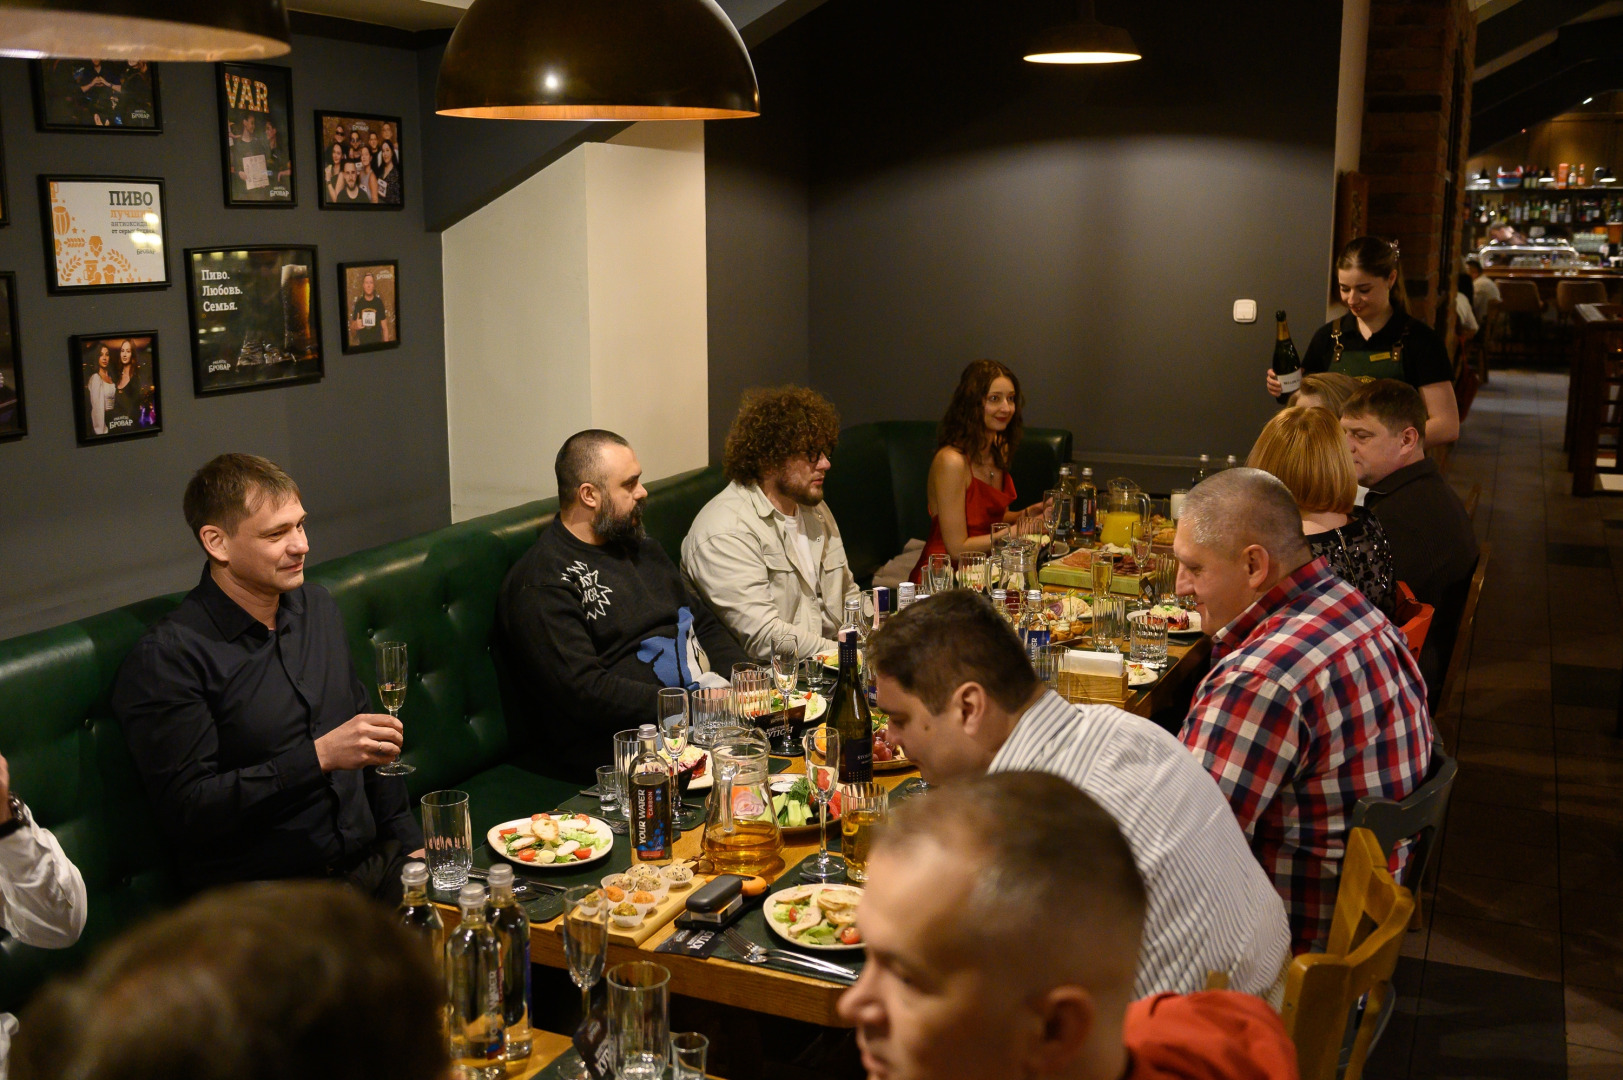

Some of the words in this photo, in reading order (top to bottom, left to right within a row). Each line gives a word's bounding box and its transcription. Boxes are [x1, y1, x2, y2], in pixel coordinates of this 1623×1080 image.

[225, 73, 269, 113] VAR
[109, 190, 153, 206] ПИВО
[201, 269, 230, 281] Пиво.
[202, 284, 243, 297] Любовь.
[203, 301, 238, 312] Семья.
[638, 789, 646, 819] WATER
[638, 821, 646, 844] YOUR
